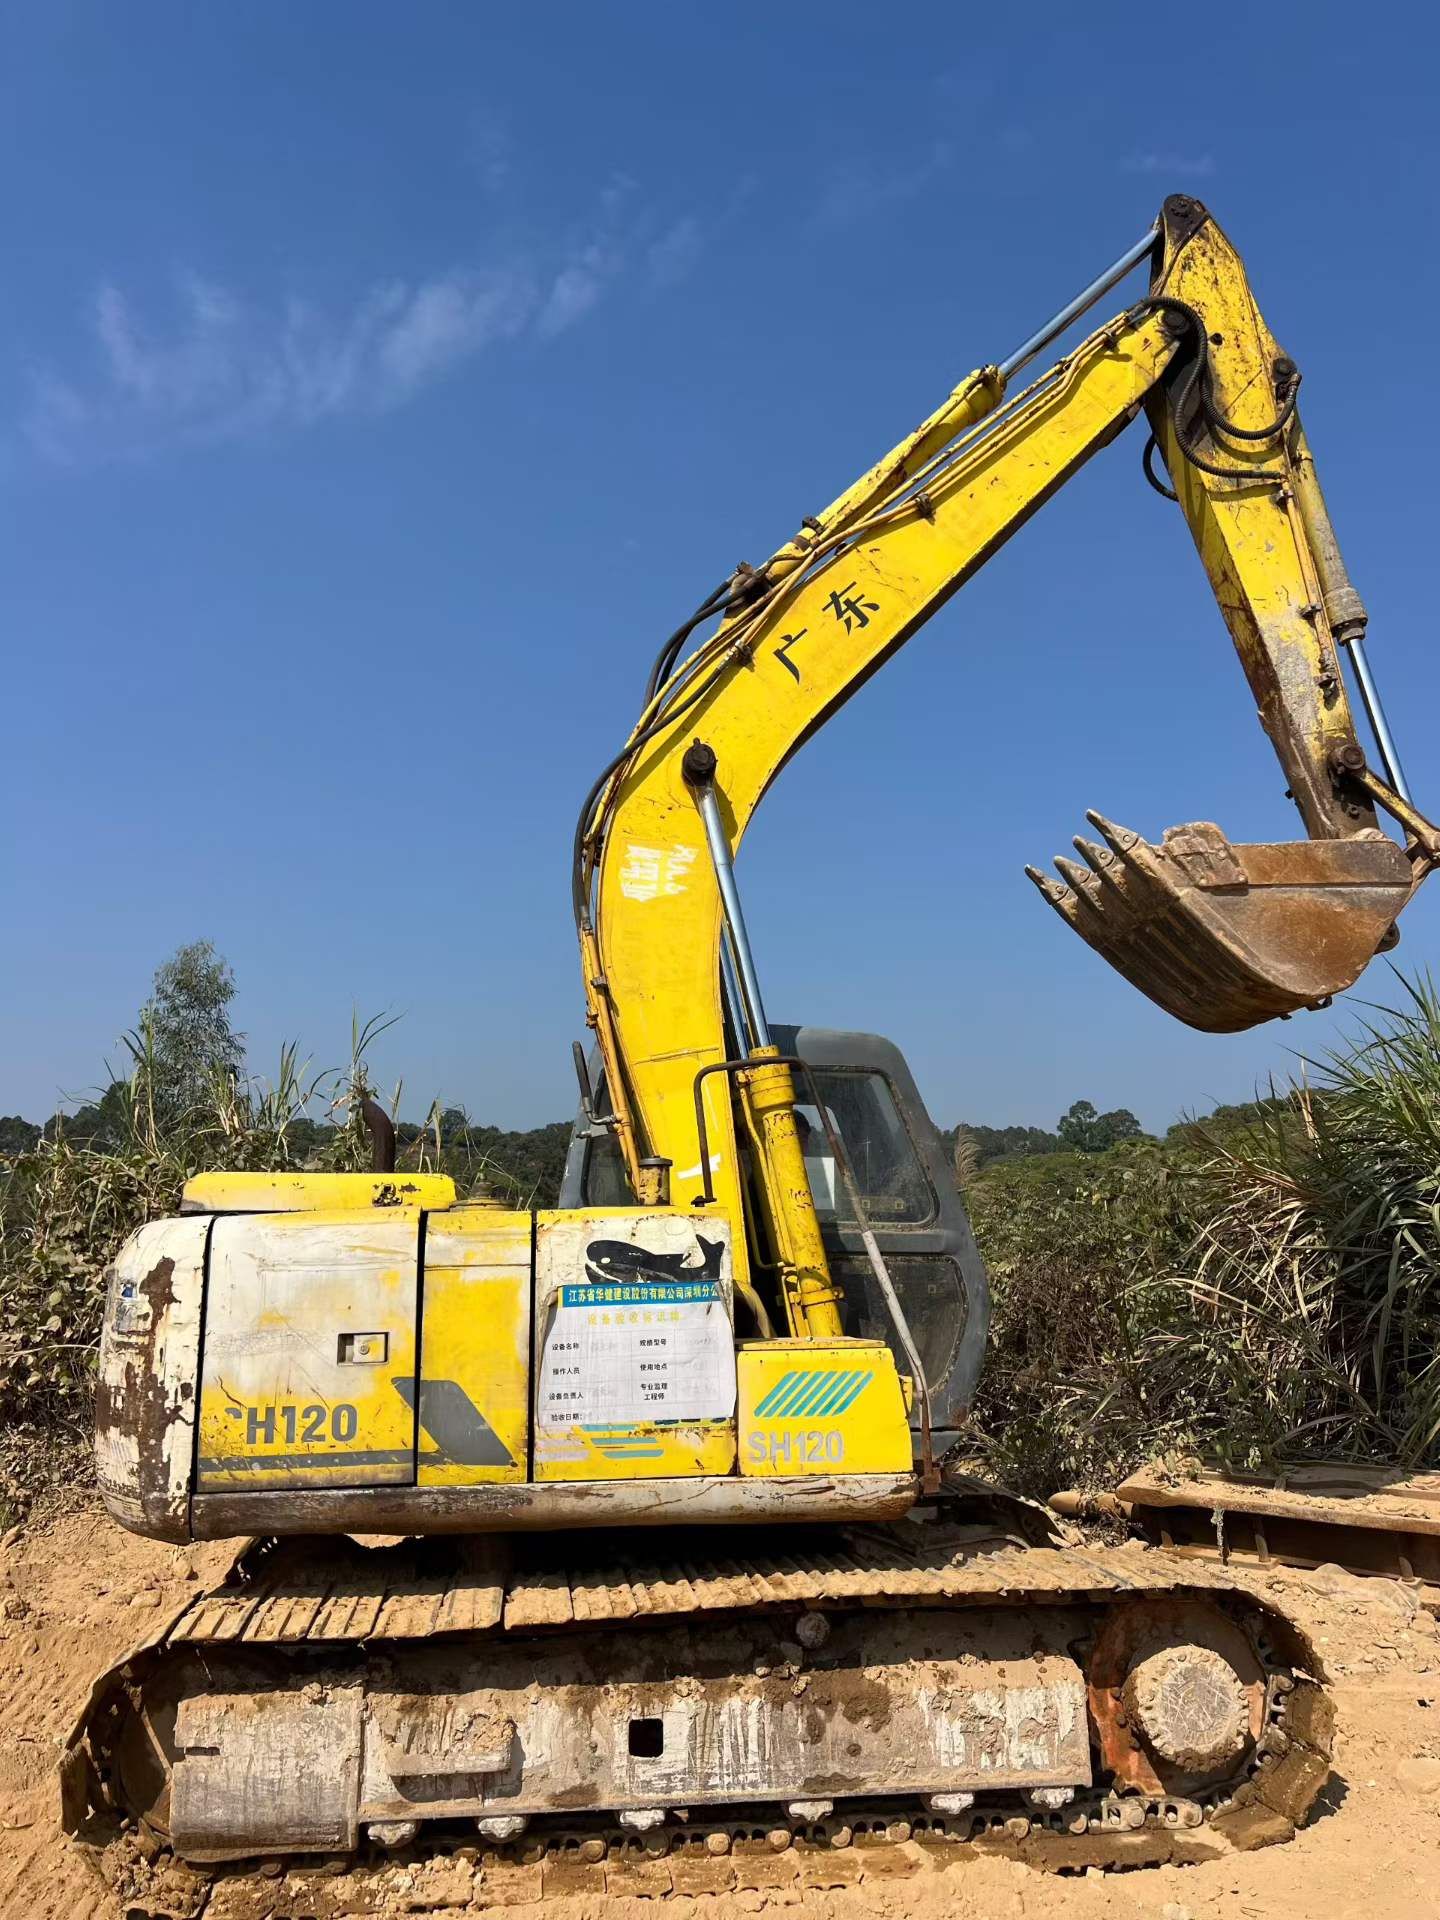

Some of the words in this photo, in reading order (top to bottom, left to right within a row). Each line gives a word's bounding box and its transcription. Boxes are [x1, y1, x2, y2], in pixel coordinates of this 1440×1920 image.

[552, 1343, 580, 1351] 设备名称
[639, 1338, 667, 1347] 规格型号
[552, 1367, 580, 1376] 操作人员
[640, 1363, 668, 1371] 使用地点
[640, 1383, 668, 1391] 专业监理
[549, 1392, 584, 1401] 设备负责人
[644, 1392, 665, 1401] 工程师
[224, 1404, 358, 1445] H120
[748, 1430, 844, 1464] SH120
